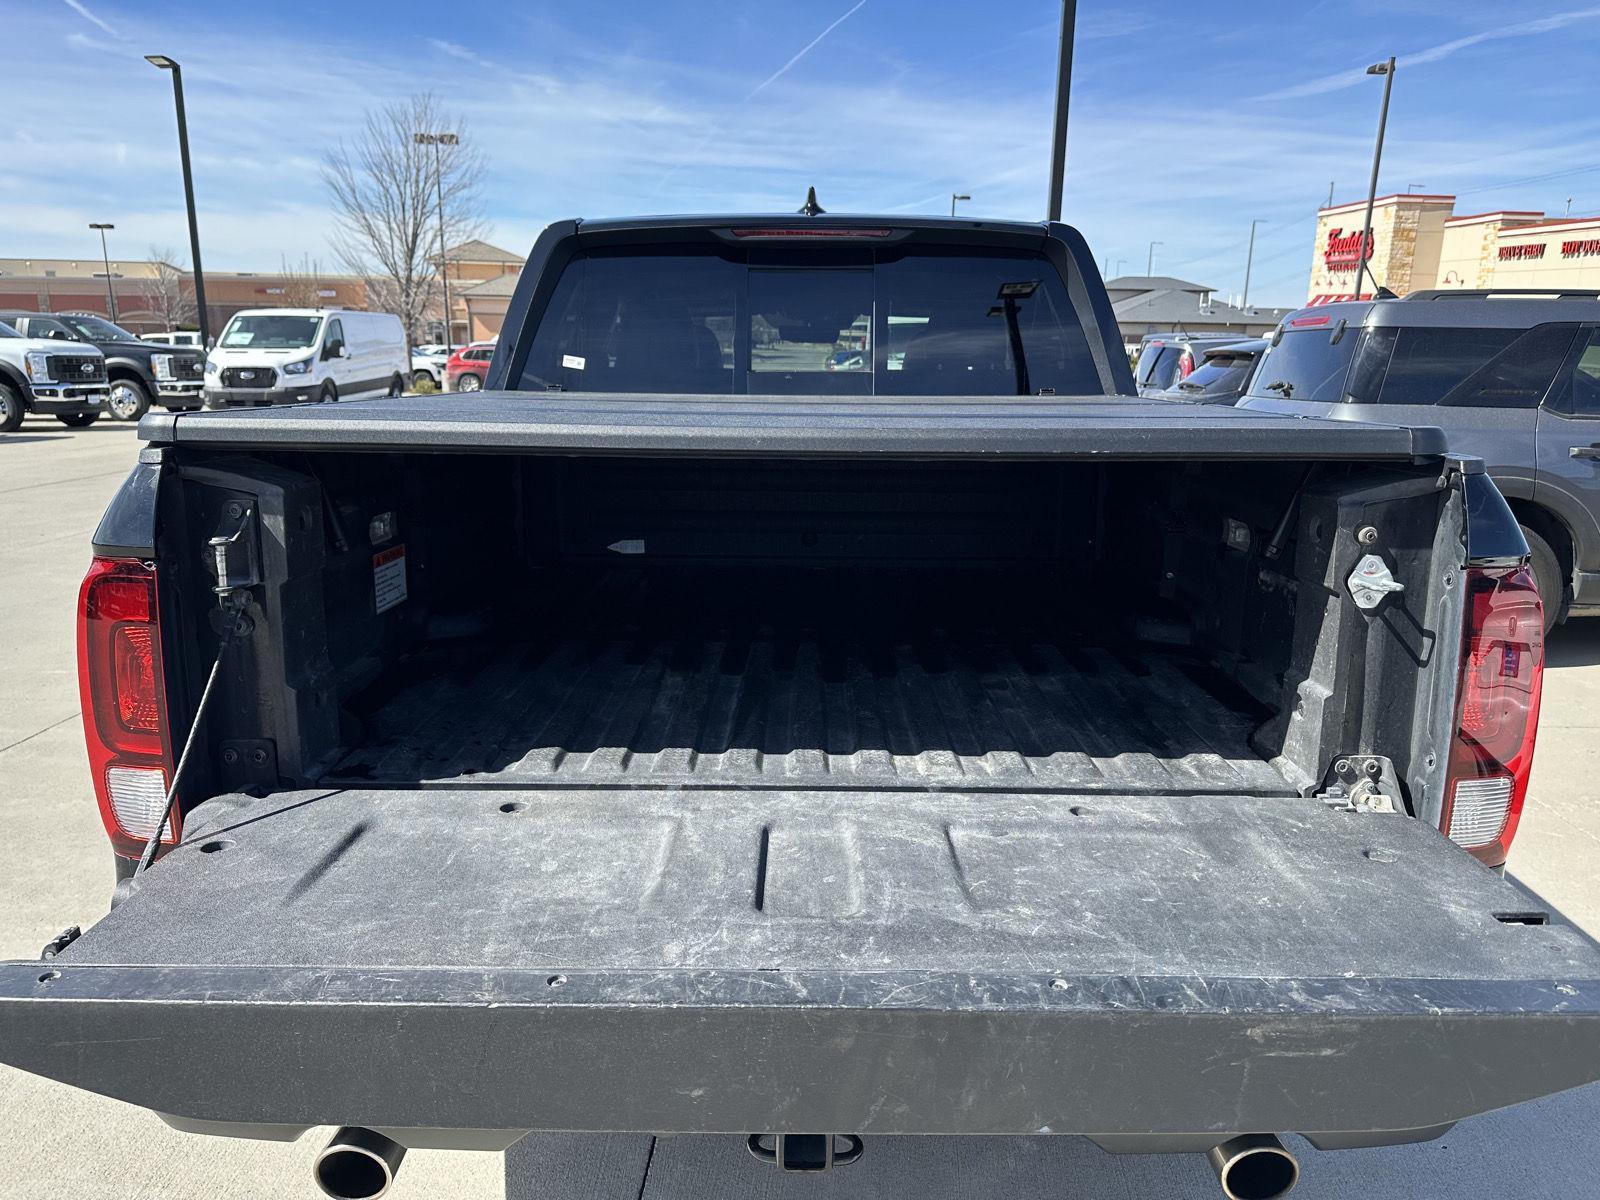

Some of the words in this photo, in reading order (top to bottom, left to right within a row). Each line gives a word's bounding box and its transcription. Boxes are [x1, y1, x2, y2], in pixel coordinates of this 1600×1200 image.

[1498, 245, 1521, 258] DRIVE
[1521, 243, 1545, 257] THRU
[1562, 241, 1579, 255] HOT
